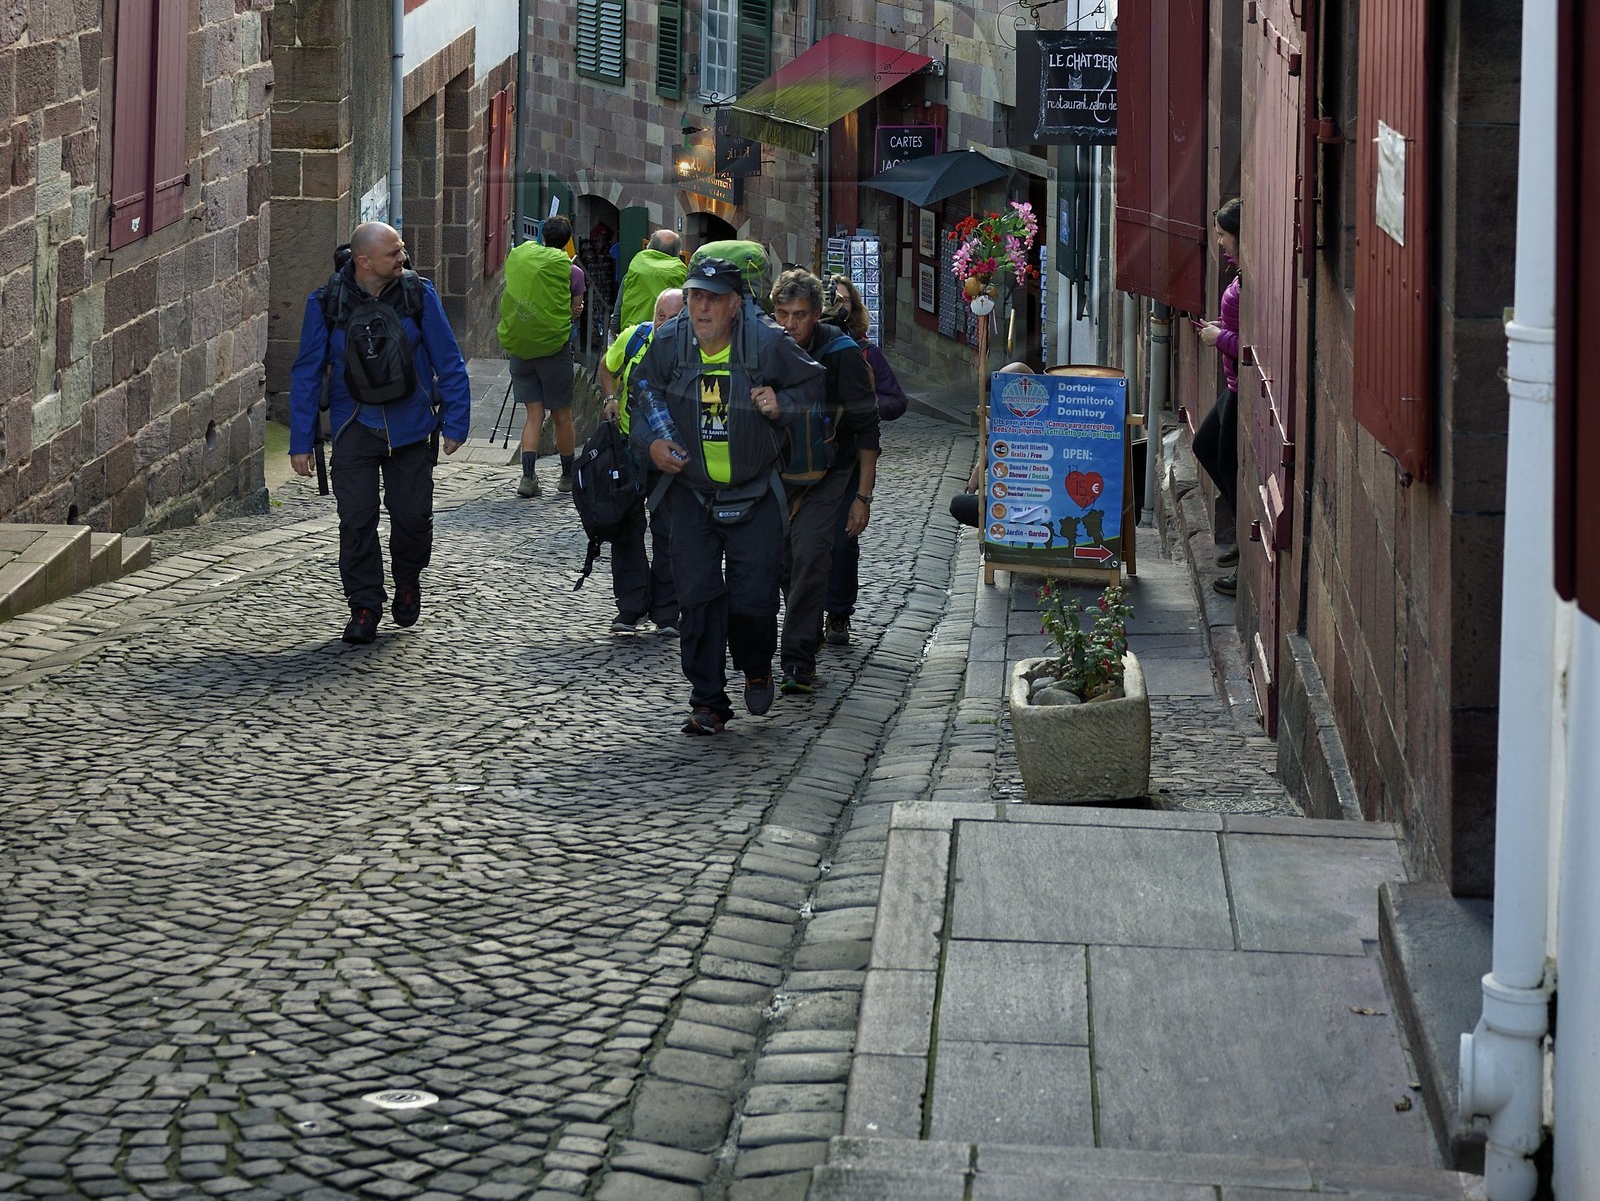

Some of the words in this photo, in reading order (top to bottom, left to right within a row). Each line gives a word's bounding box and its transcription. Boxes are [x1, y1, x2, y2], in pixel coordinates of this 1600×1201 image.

[1049, 54, 1064, 68] LE
[1066, 52, 1094, 71] CHAT
[1047, 94, 1088, 110] restaurant
[1088, 94, 1107, 111] salon
[890, 136, 922, 148] CARTES
[1058, 382, 1096, 393] Dortoir
[1058, 394, 1114, 406] Dormitorio
[1057, 406, 1106, 420] Domitory
[1048, 420, 1067, 428] Camas
[1083, 423, 1114, 431] peregrinos
[1018, 428, 1042, 436] pilgrims
[1062, 448, 1093, 460] OPEN:
